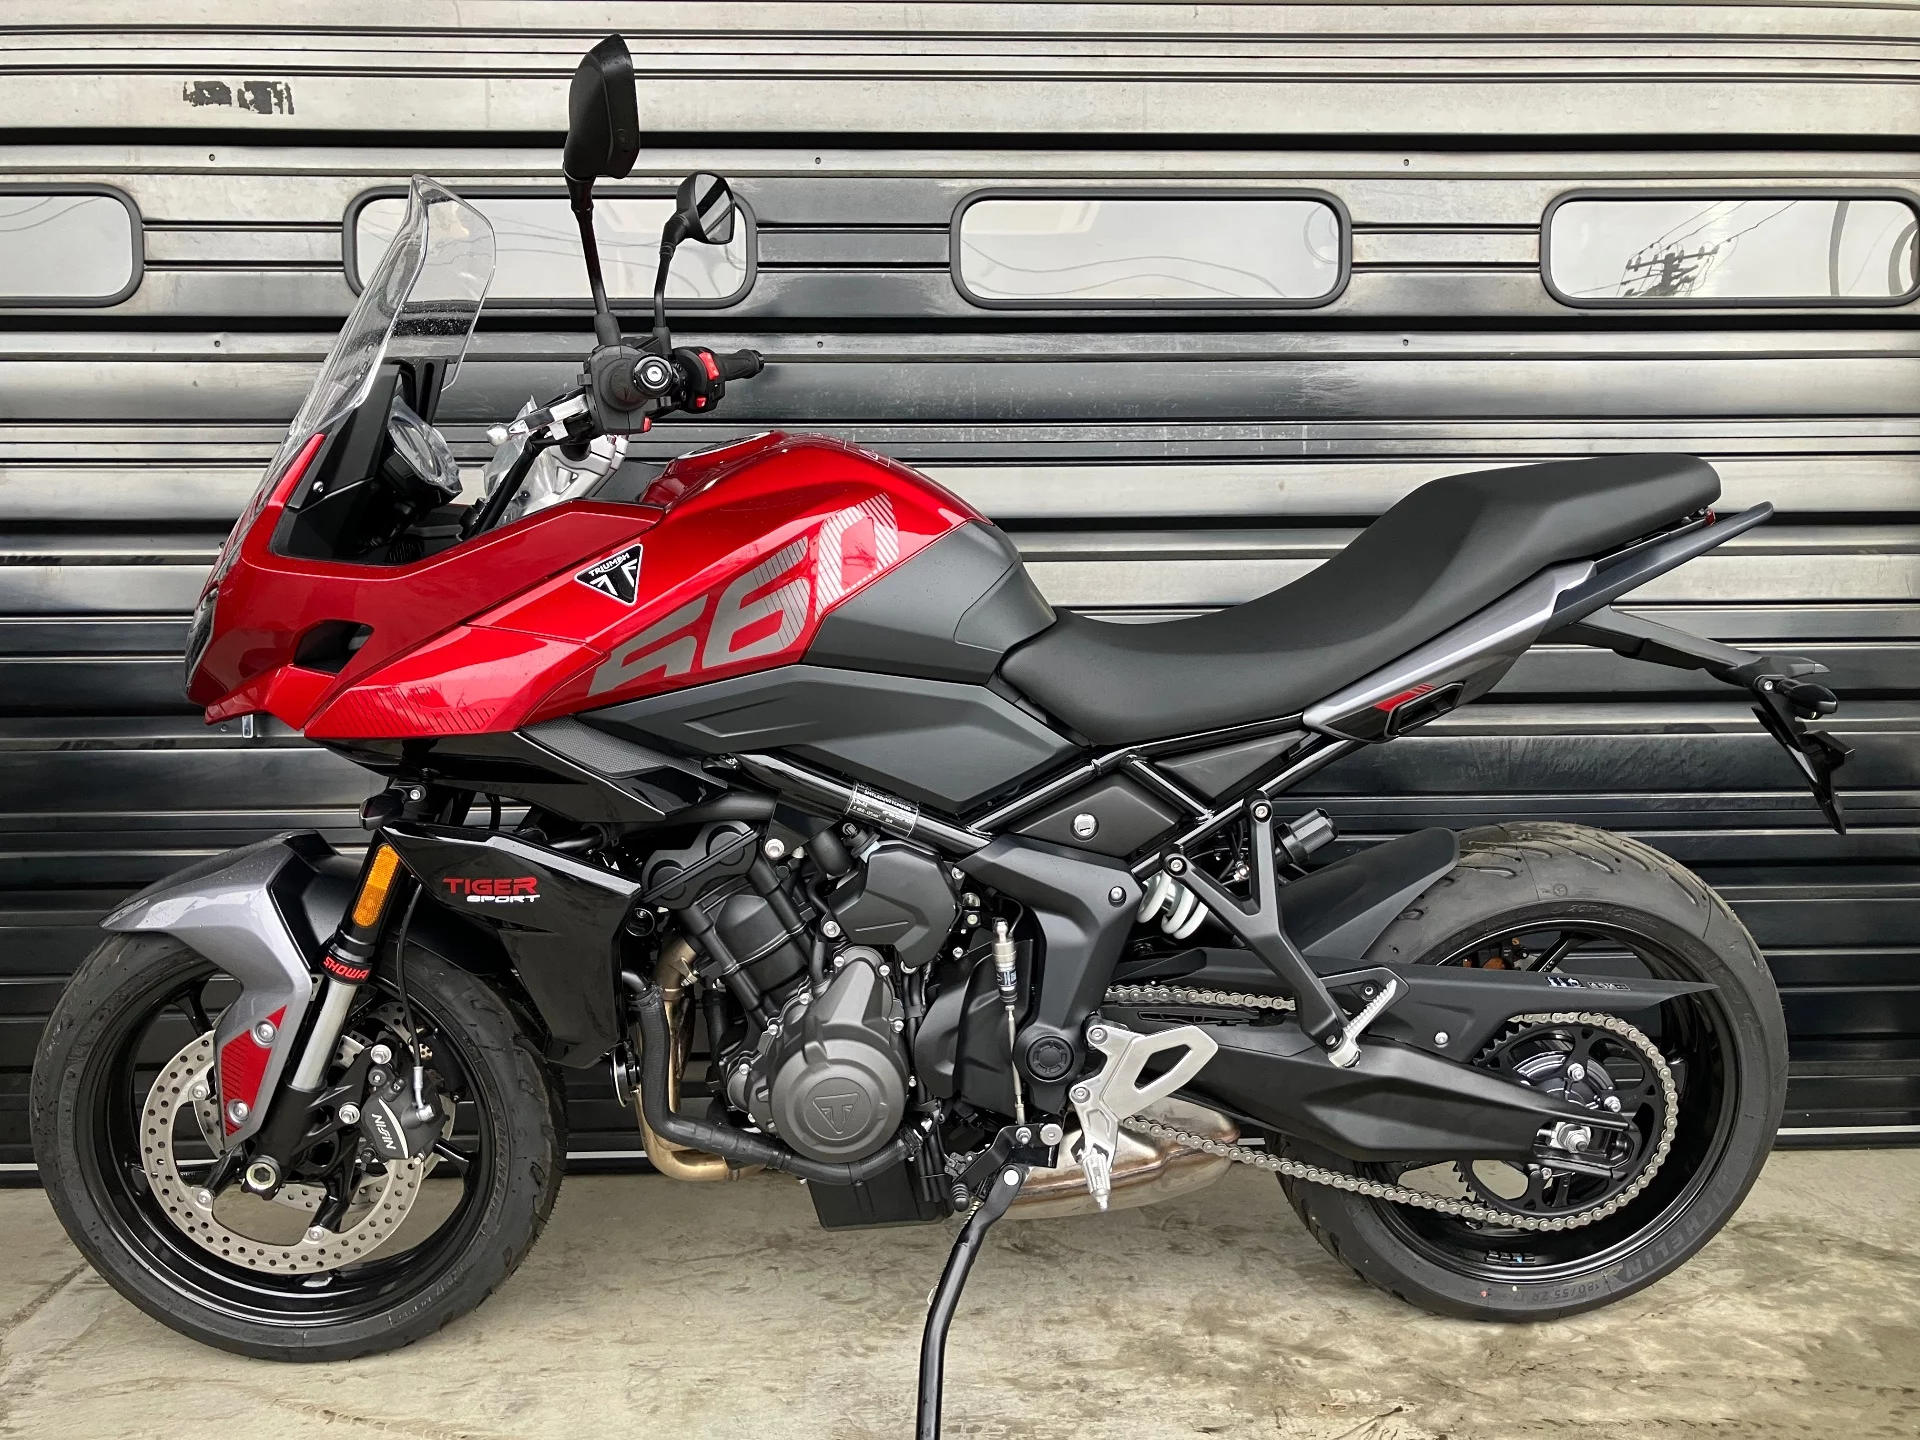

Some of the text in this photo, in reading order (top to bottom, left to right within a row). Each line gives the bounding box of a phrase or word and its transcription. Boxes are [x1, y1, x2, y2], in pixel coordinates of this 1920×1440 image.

[588, 553, 630, 576] TRIUMPH
[586, 492, 899, 697] 660
[443, 877, 537, 895] TIGER
[466, 894, 541, 903] SPORT
[323, 956, 370, 979] SHOWA
[371, 1113, 397, 1150] NISSIN
[1554, 1282, 1600, 1300] 180/55
